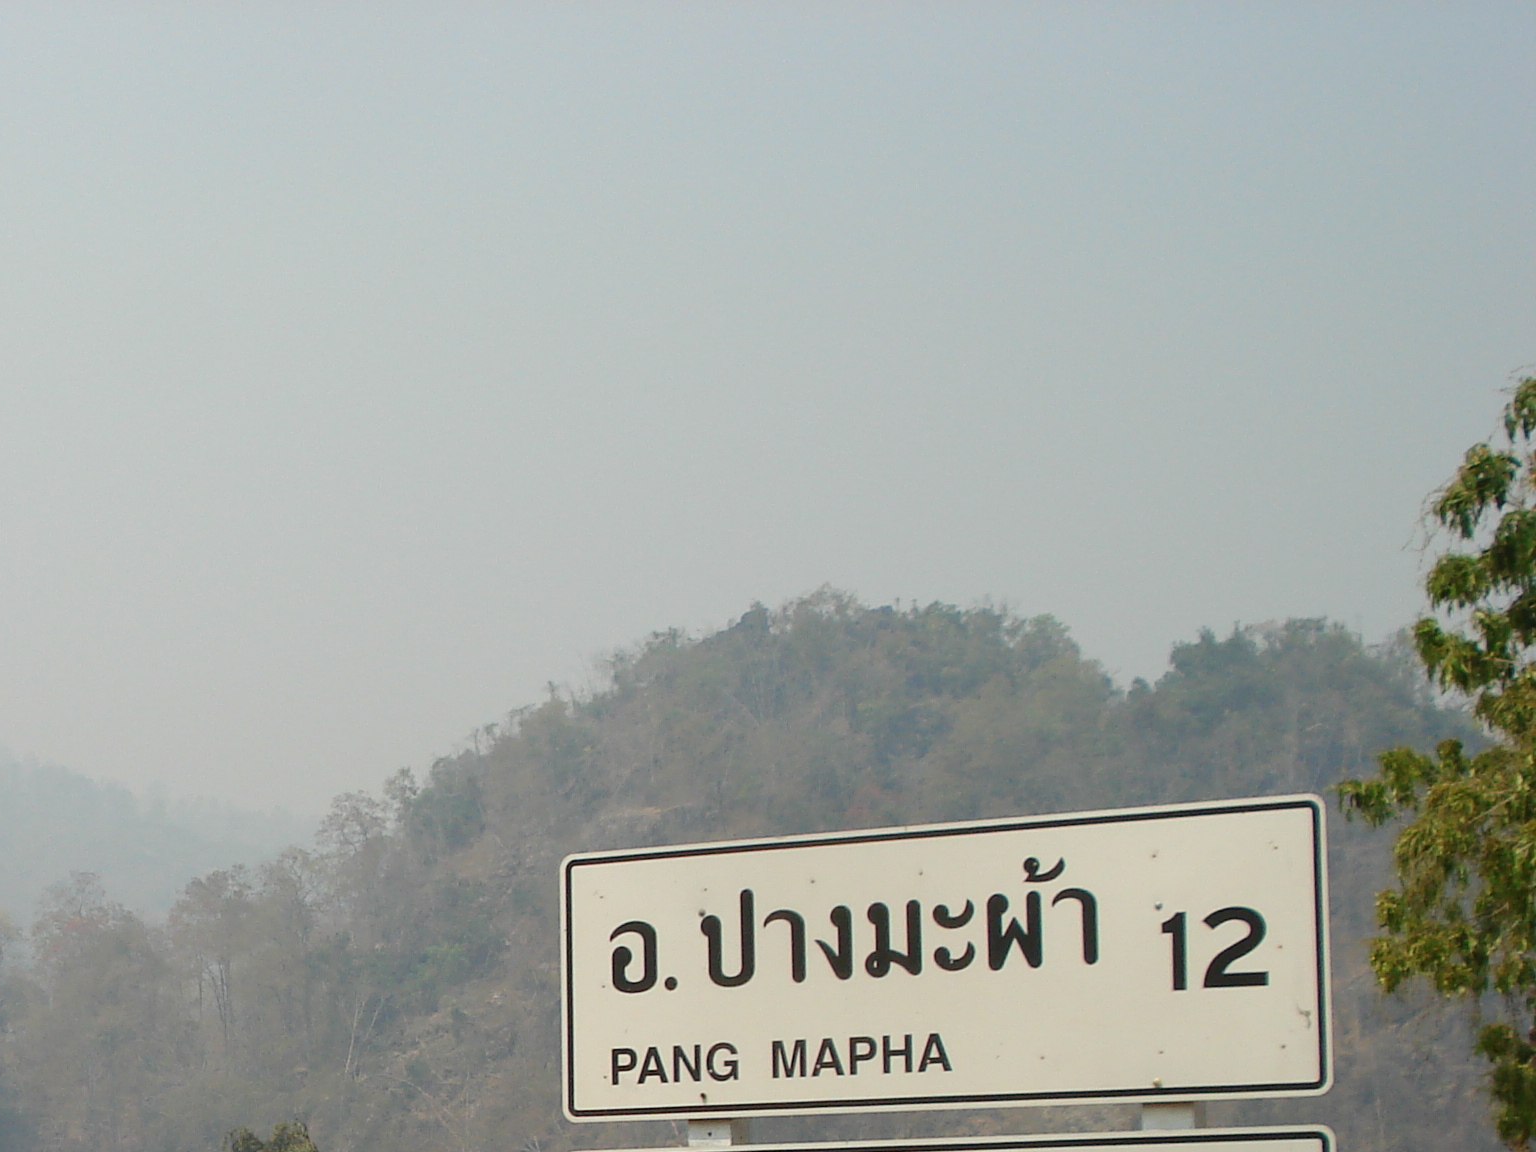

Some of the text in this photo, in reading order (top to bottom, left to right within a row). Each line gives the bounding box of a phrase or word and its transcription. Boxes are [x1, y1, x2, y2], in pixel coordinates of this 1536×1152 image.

[609, 857, 1269, 995] อ. ปางมะผ้า 12
[611, 1033, 953, 1086] PANG MAPHA
